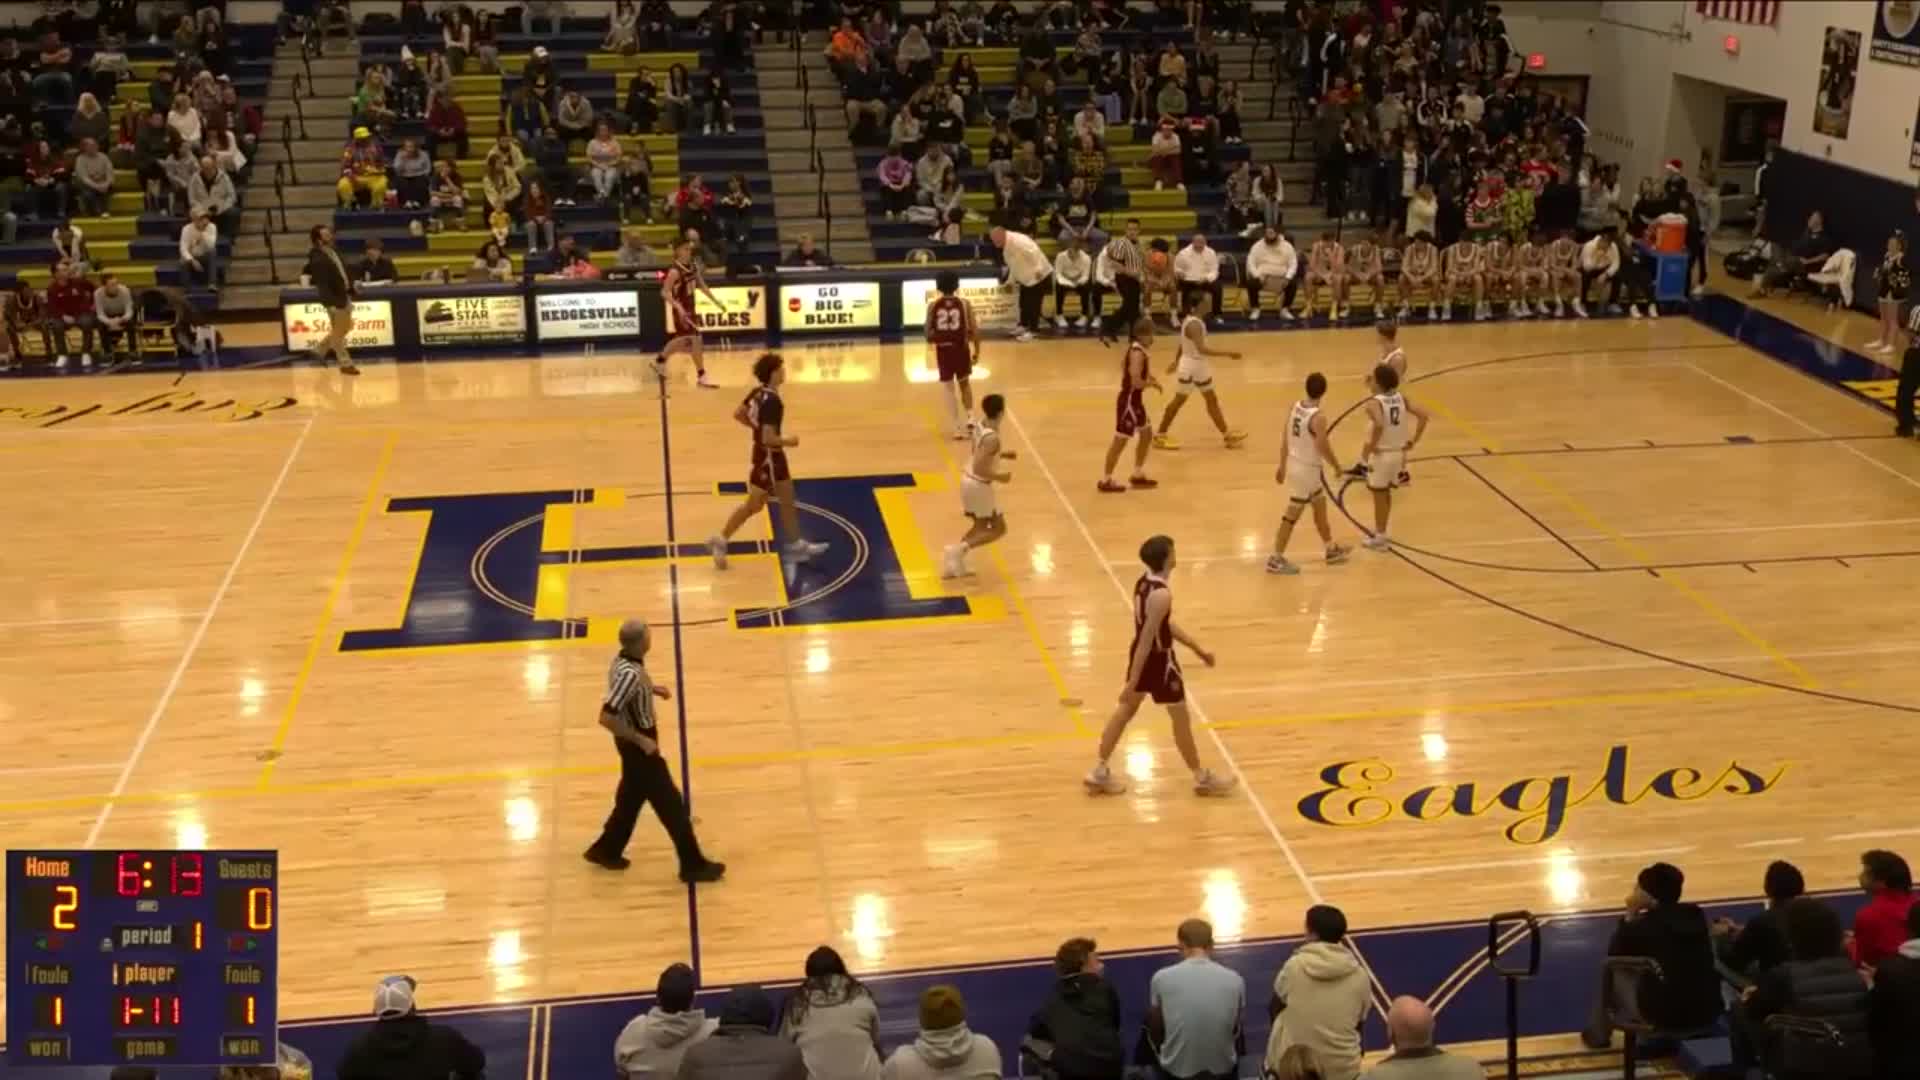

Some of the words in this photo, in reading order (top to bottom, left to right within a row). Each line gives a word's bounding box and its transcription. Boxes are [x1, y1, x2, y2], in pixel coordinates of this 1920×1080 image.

[818, 287, 838, 298] GO
[456, 298, 489, 310] FIVE
[815, 300, 843, 311] BIG
[456, 309, 489, 321] STAR
[541, 307, 637, 321] HEDGESVILLE
[695, 312, 751, 328] AGLES
[805, 312, 854, 325] BLUE!
[936, 309, 961, 331] 23
[579, 321, 600, 329] HIGH
[602, 319, 637, 329] SCHOOL
[1297, 745, 1785, 845] Eagles
